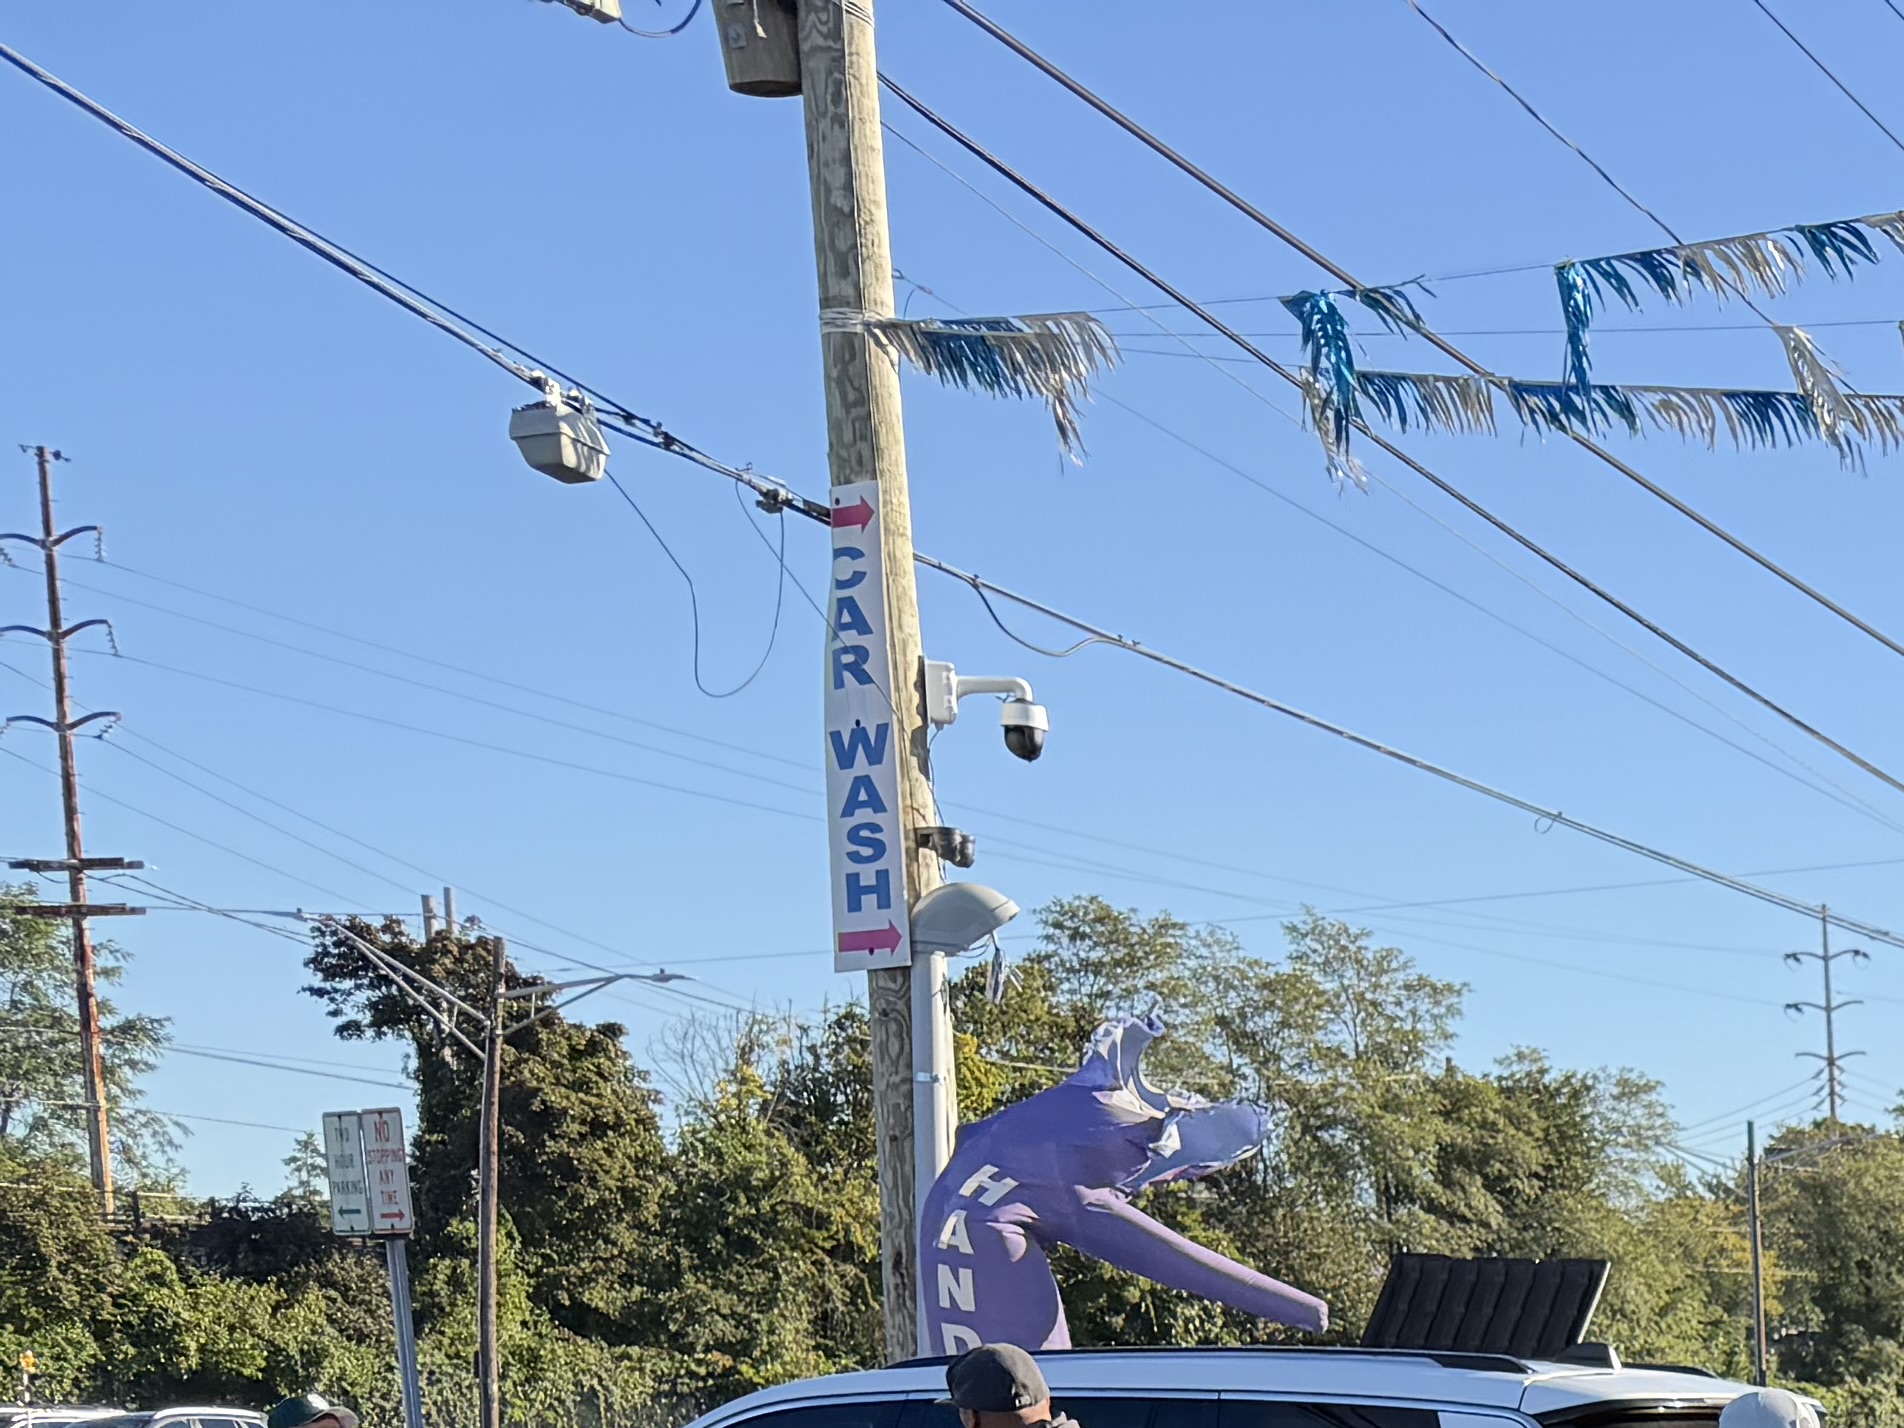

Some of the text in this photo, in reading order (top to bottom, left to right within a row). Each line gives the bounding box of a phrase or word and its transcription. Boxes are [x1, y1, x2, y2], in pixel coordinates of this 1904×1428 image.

[829, 545, 892, 914] CAR WASH
[374, 1120, 390, 1143] NO
[367, 1148, 404, 1165] STOPPING
[380, 1169, 394, 1184] ANY
[332, 1180, 363, 1195] PARKING
[381, 1190, 399, 1206] TIME
[937, 1164, 1020, 1356] HAND
